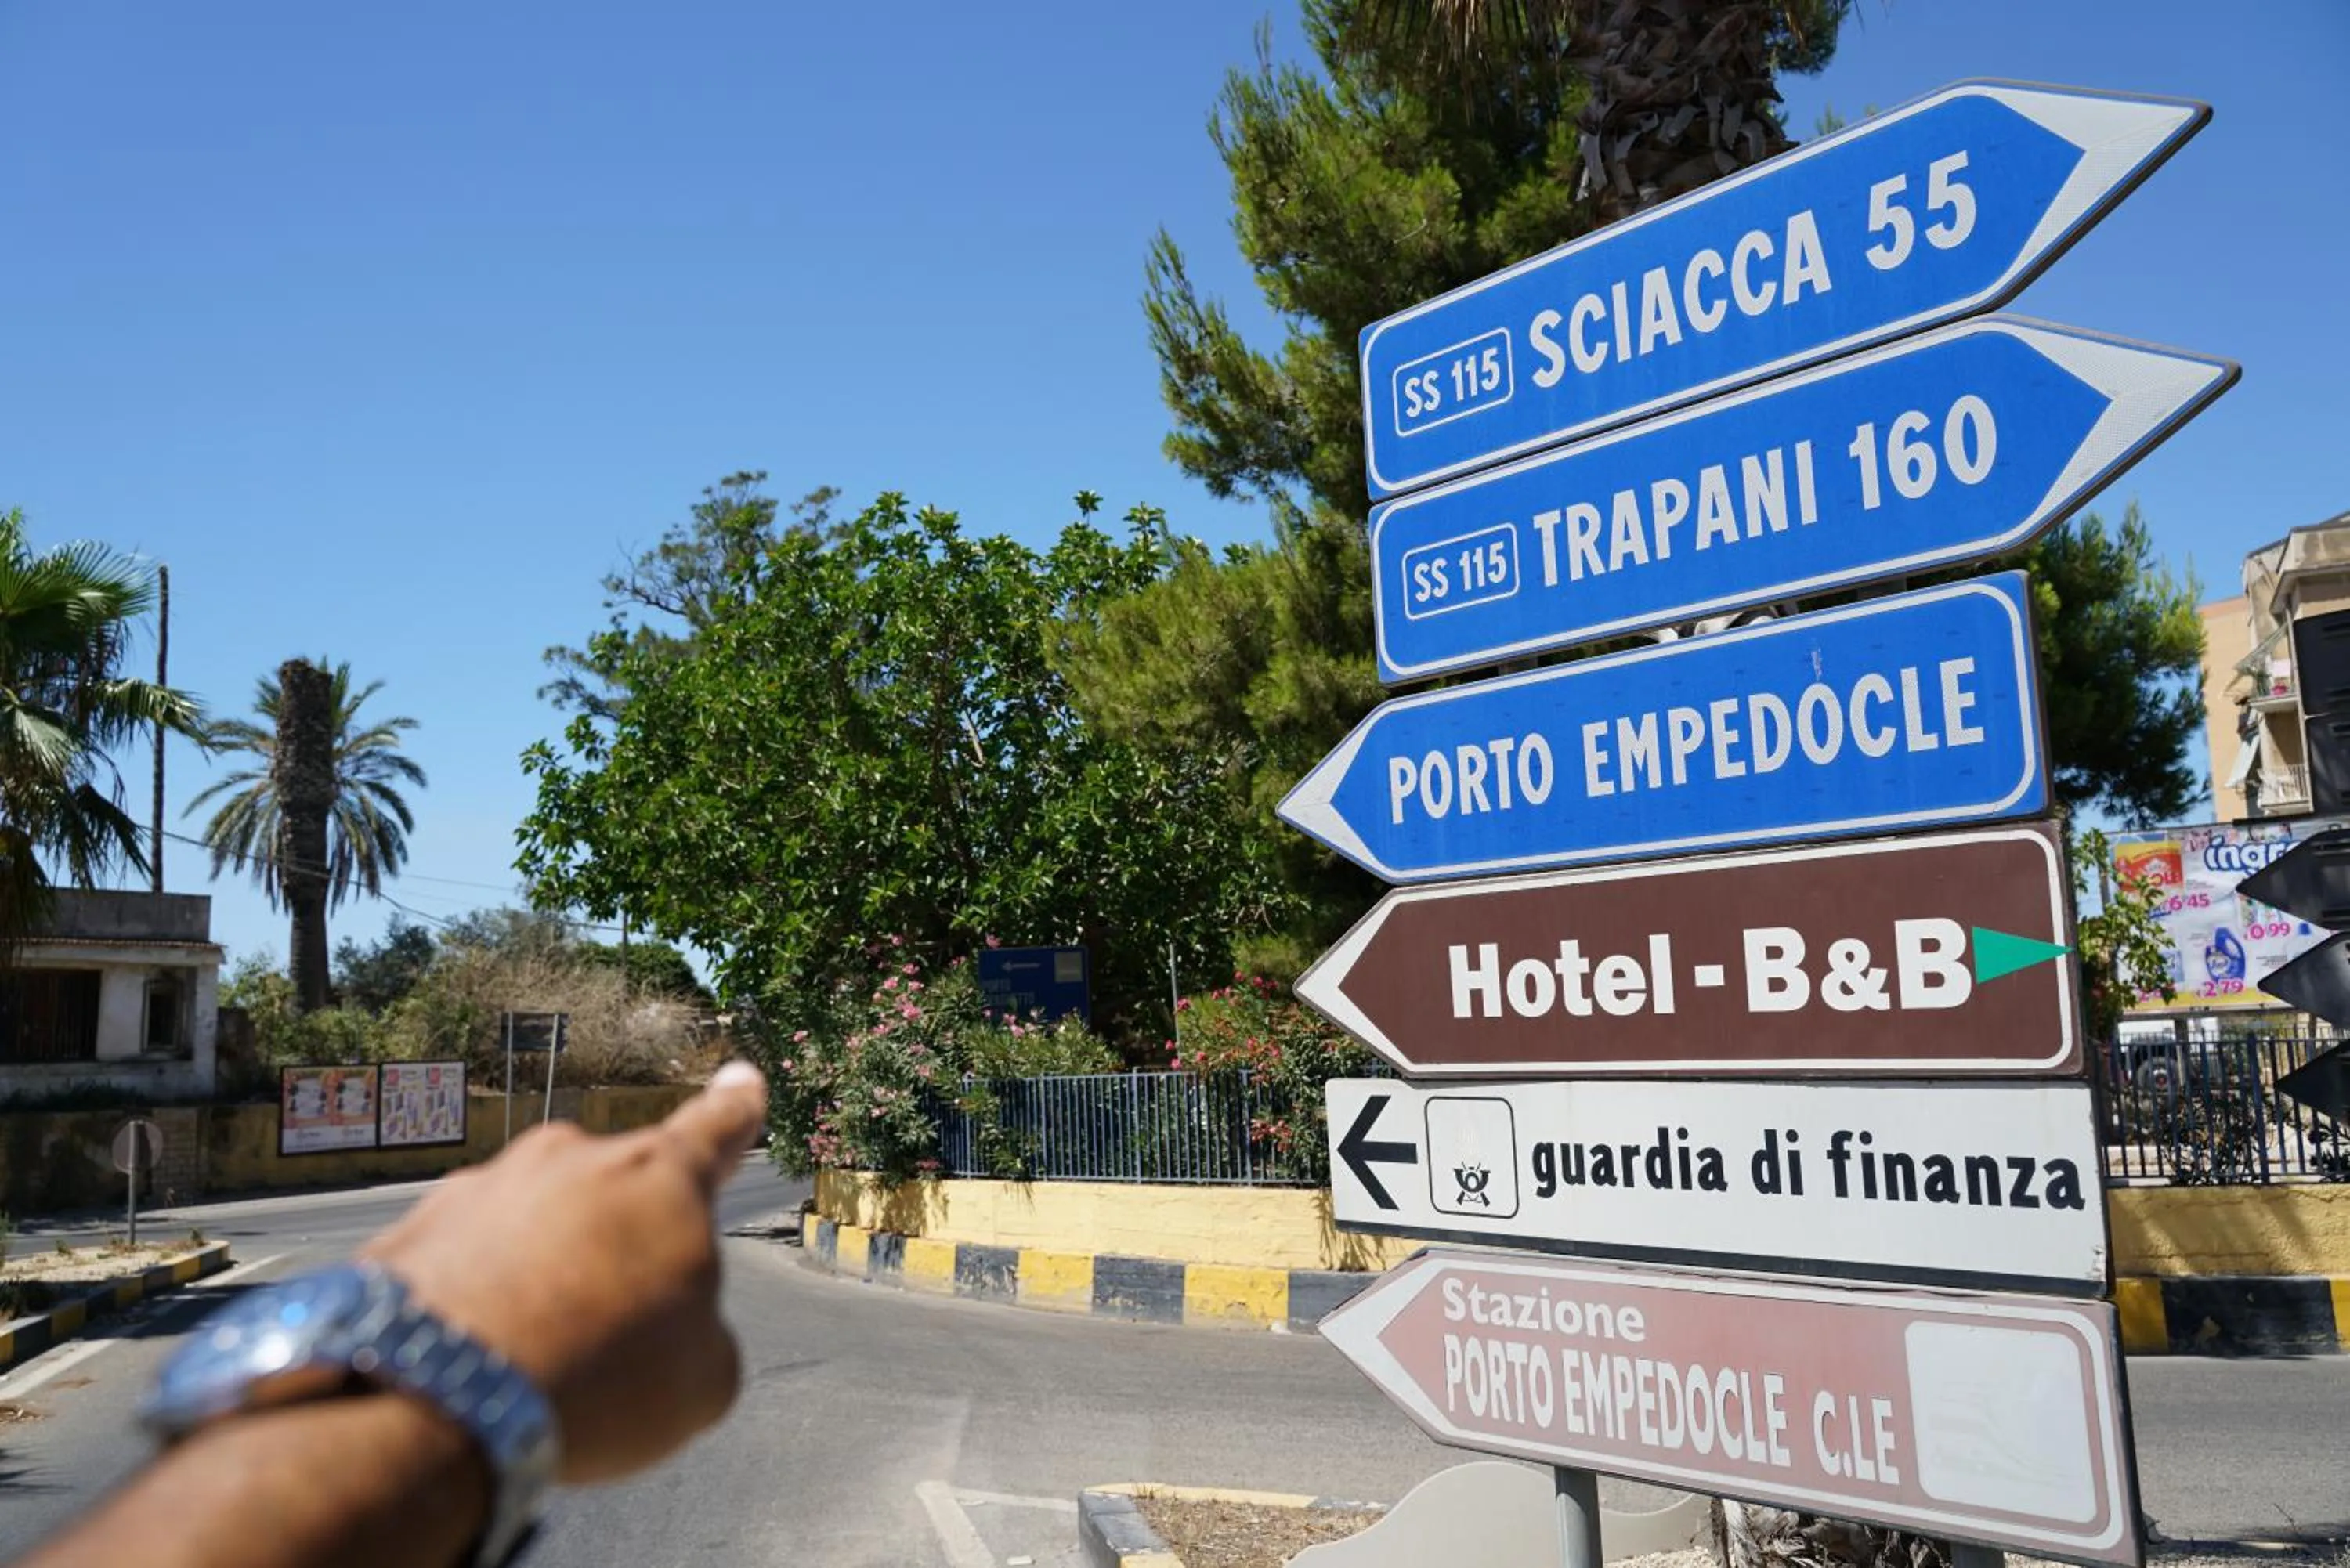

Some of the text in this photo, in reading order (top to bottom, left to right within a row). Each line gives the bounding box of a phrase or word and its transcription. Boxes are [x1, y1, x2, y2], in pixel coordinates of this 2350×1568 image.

[1405, 150, 1976, 417] SS 115 SCIACCA 55
[1415, 395, 1997, 602] SS 115 TRAPANI 160
[1390, 657, 1984, 824] PORTO EMPEDOCLE
[2204, 835, 2301, 876] ingr
[1449, 934, 1675, 1017] Hotel
[1744, 918, 1971, 1012] B&B
[1532, 1127, 2085, 1210] guardia di finanza
[1443, 1278, 1644, 1341] Stazione
[1444, 1335, 1899, 1485] PORTO EMPEDOCLE C.LE
